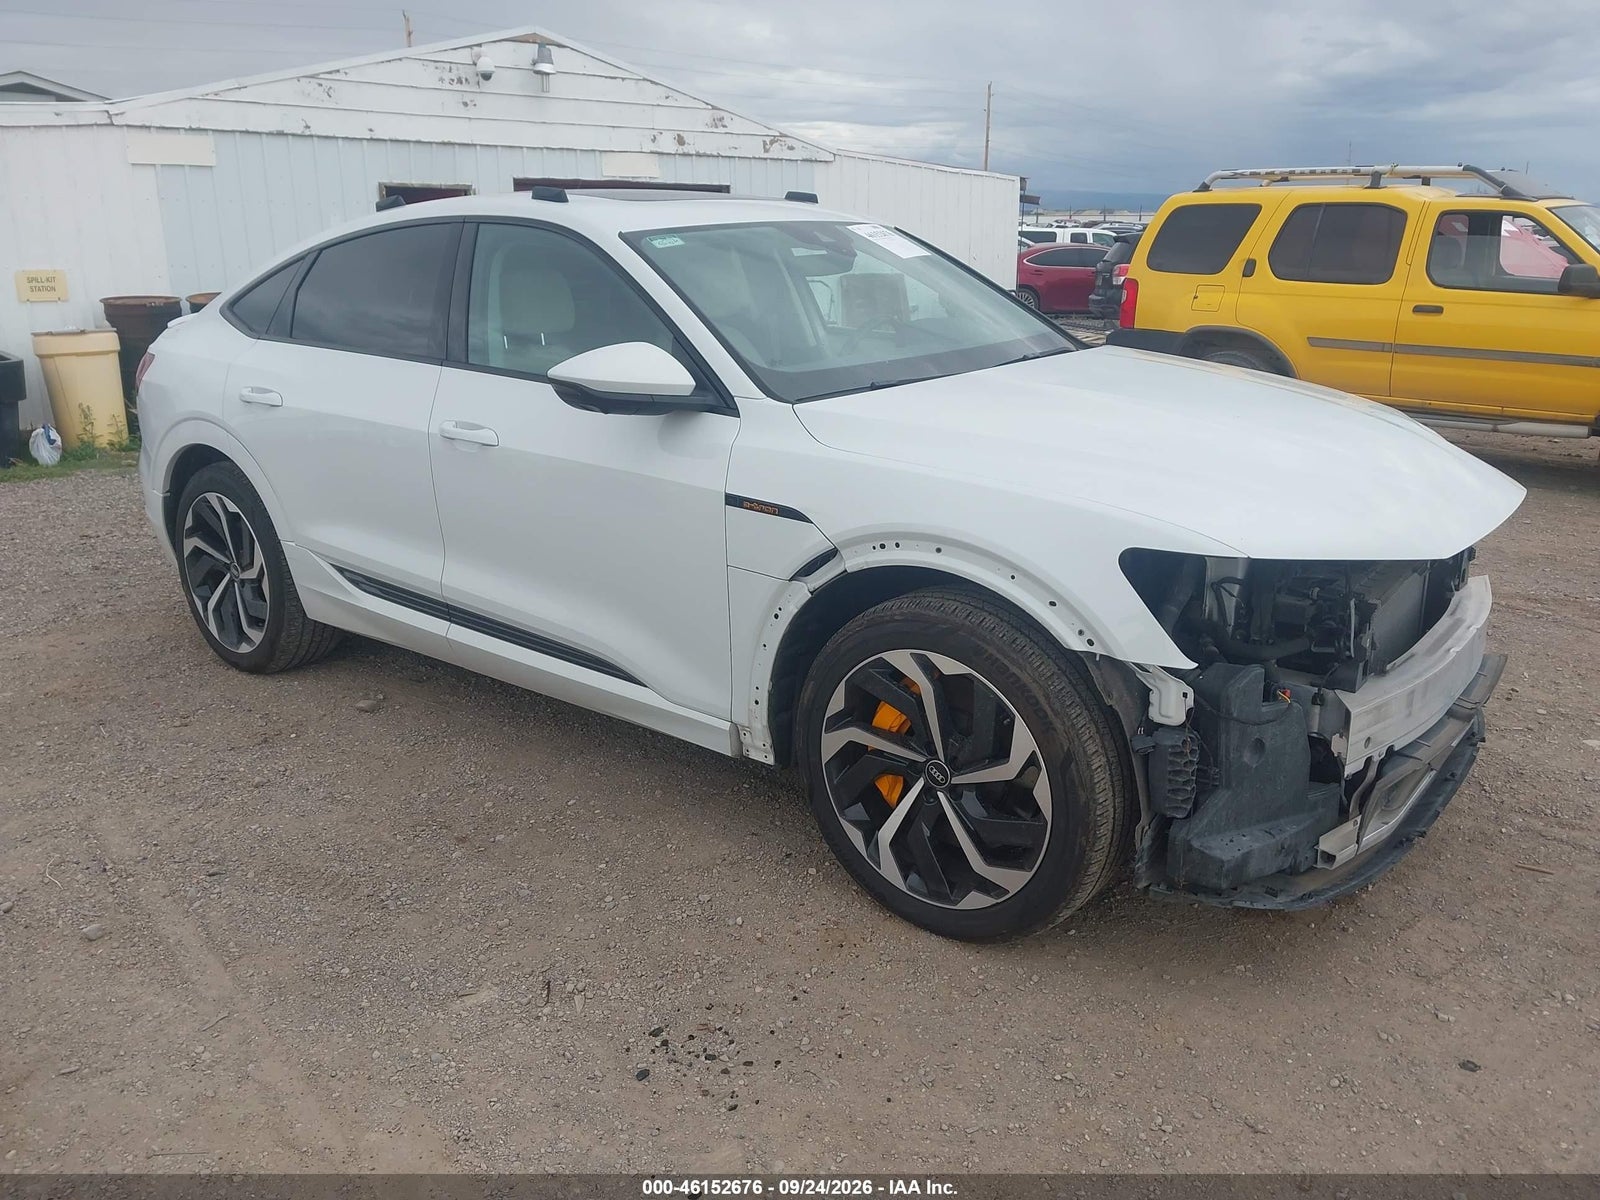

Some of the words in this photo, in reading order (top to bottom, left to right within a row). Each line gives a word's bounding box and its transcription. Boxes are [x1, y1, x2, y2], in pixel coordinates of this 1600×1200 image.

[26, 276, 56, 284] SPILL-KIT
[29, 285, 56, 293] STATION
[743, 501, 779, 514] e-tron
